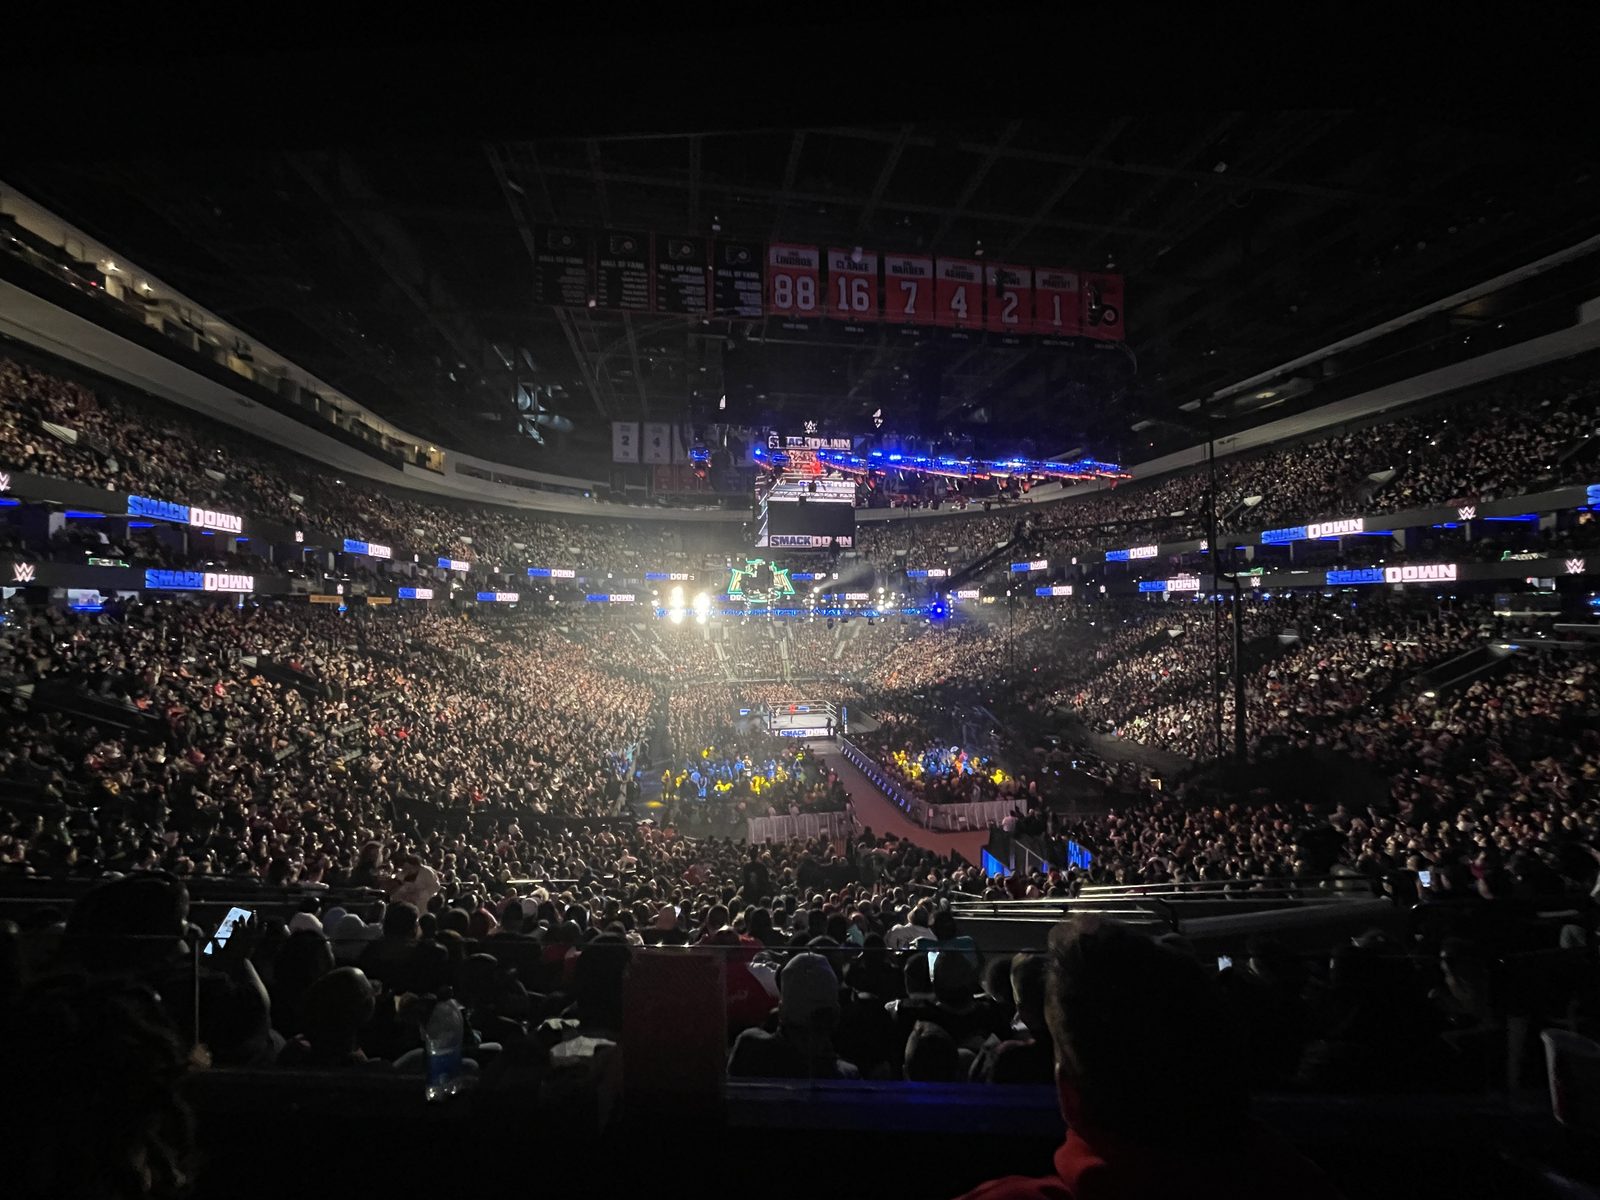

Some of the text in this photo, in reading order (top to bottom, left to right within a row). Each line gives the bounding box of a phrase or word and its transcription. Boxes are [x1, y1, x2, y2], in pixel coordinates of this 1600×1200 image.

[775, 273, 816, 311] 88
[838, 276, 870, 312] 16
[900, 280, 918, 314] 7
[951, 286, 968, 319] 4
[1002, 291, 1019, 324] 2
[1053, 294, 1063, 326] 1
[621, 435, 630, 446] 2
[128, 495, 242, 533] SMACKDOWN
[770, 535, 852, 548] SMACKDON
[1261, 518, 1363, 544] SMACKDOWN
[145, 569, 254, 592] SMACKDOWN
[1326, 564, 1456, 585] SMACKDOWN
